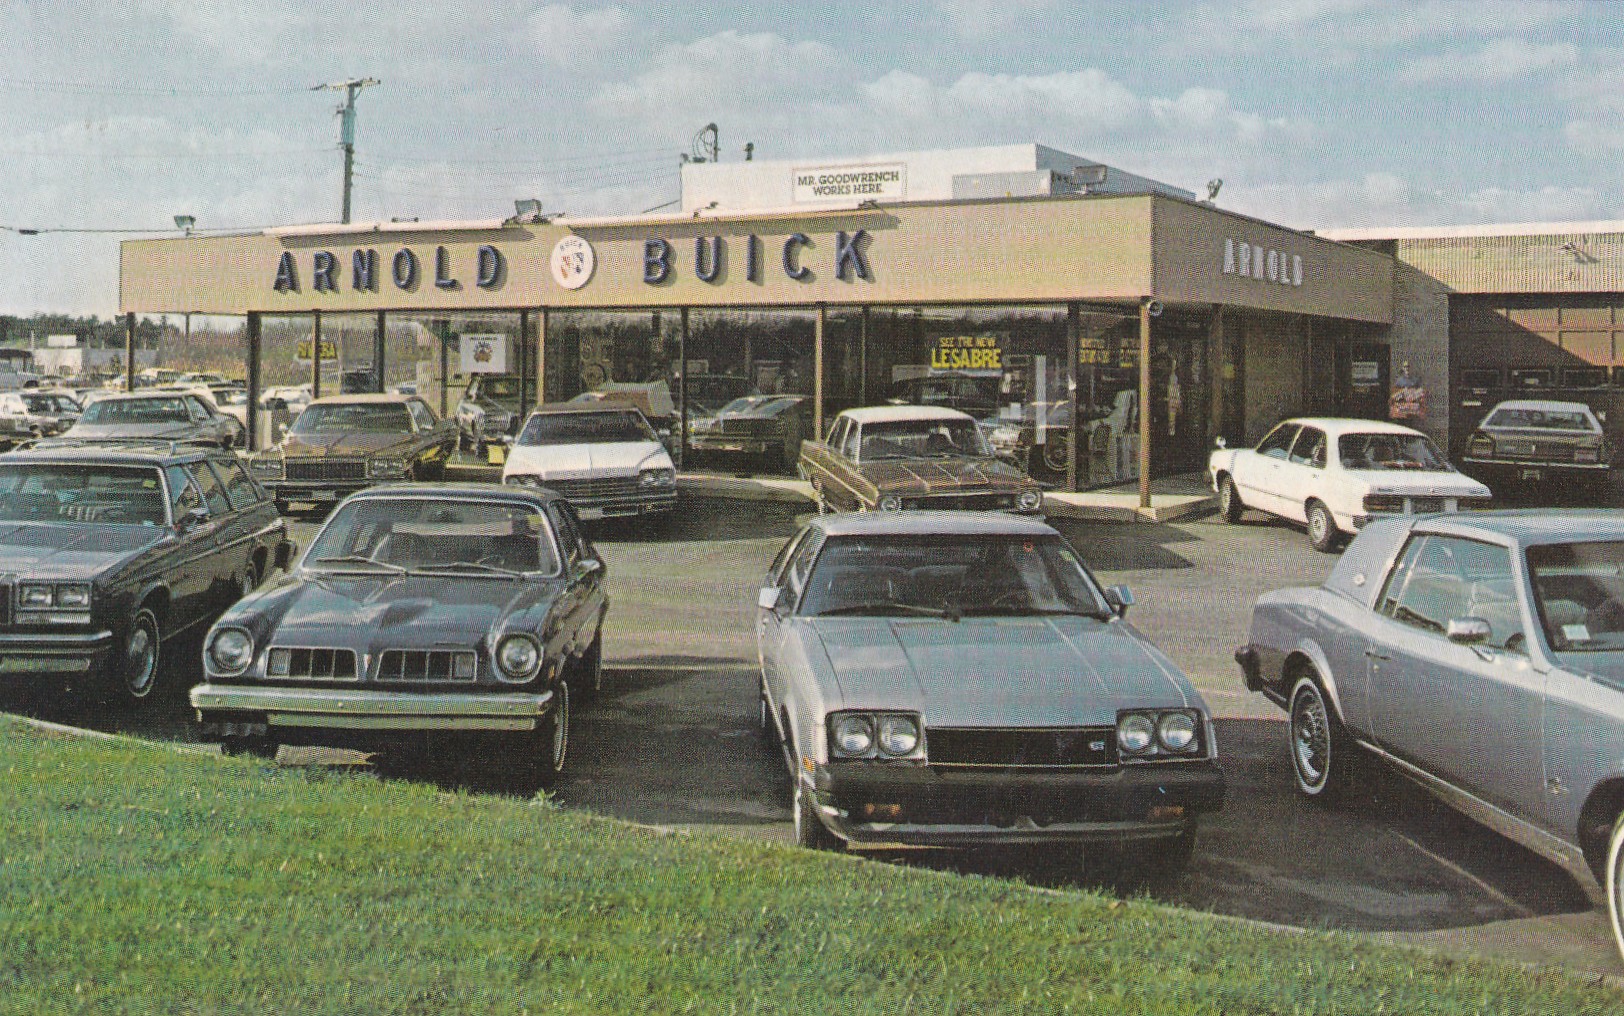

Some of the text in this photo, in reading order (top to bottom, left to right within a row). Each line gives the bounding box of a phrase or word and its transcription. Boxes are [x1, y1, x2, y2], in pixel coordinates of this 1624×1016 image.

[798, 171, 900, 186] MR. GOODWRENCH
[813, 183, 884, 196] WORKS HERE.
[273, 229, 869, 292] ARNOLD BUICK
[1223, 238, 1303, 286] ARNOLD
[939, 335, 997, 348] SEE THE NEW
[931, 348, 1002, 369] LESABRE
